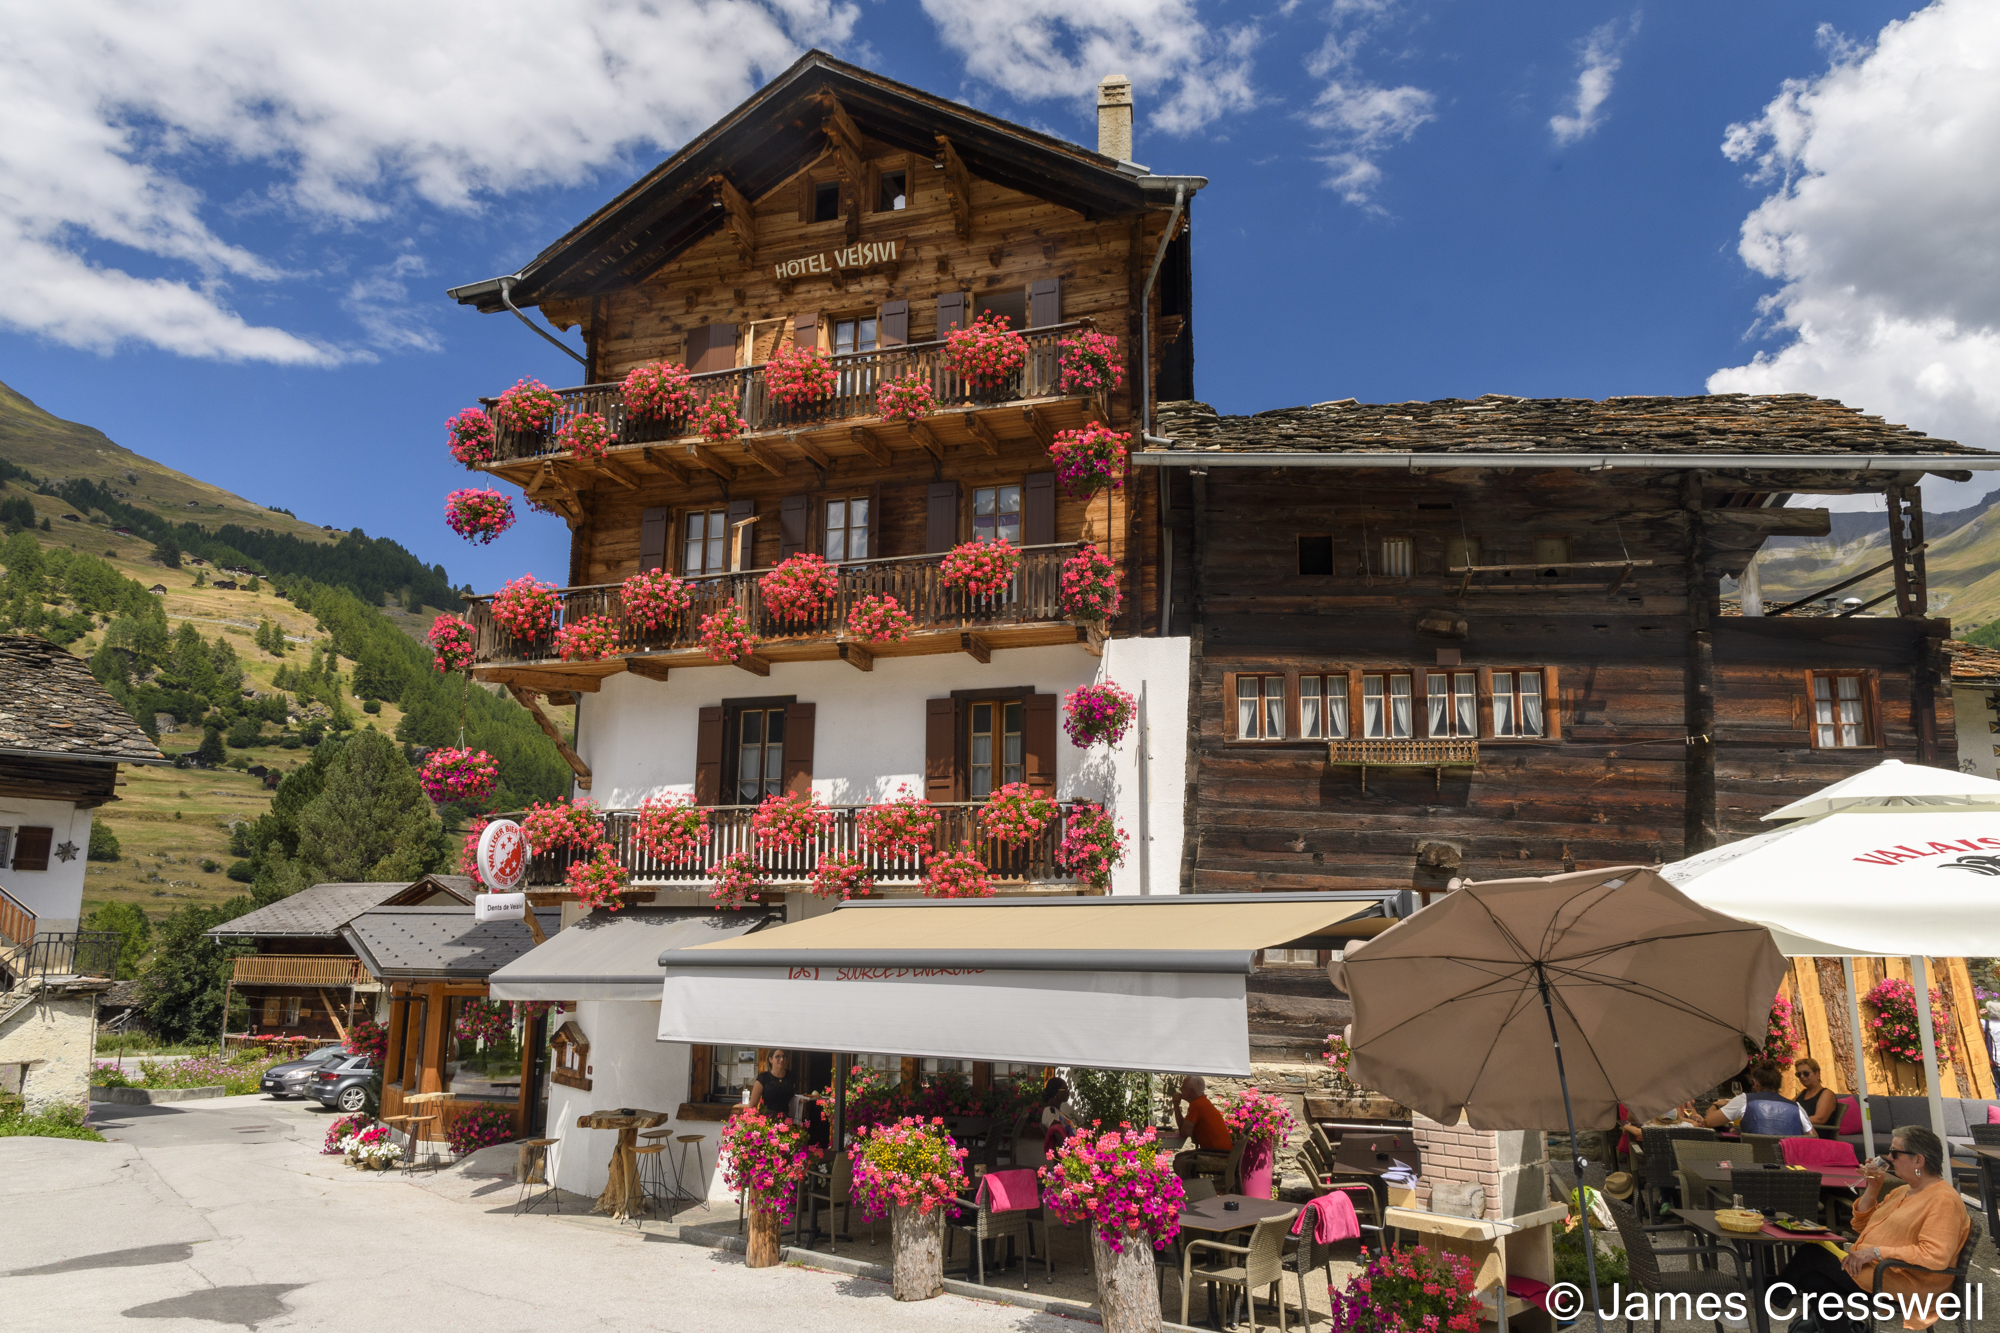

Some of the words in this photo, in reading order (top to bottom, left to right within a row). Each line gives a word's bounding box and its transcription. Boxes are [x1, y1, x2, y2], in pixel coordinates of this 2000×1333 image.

[775, 253, 832, 279] HÔTEL
[834, 241, 897, 268] VEISIVI
[488, 828, 504, 871] WALLISER
[505, 825, 518, 836] BIER
[503, 903, 509, 911] de
